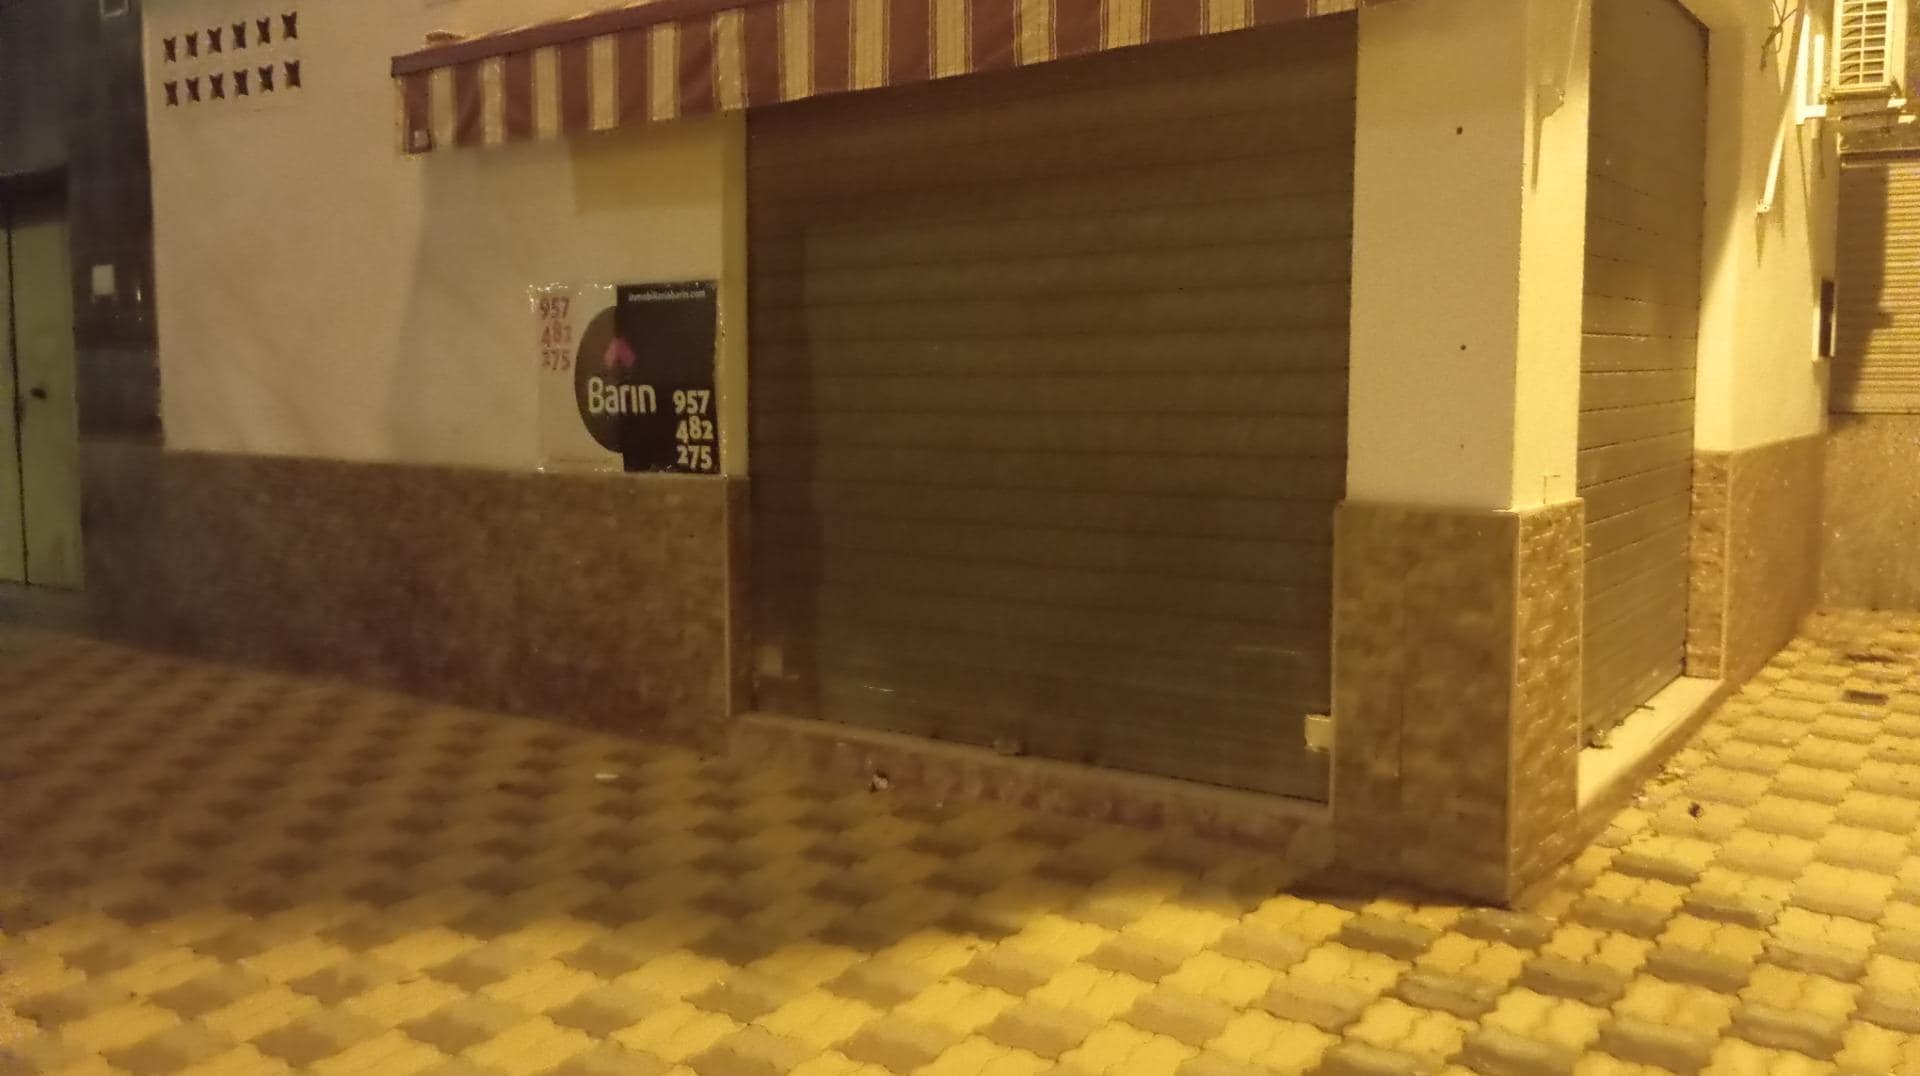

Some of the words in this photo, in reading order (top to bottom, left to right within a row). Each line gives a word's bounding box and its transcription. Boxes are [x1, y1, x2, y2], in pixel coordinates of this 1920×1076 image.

[539, 297, 569, 319] 957
[588, 376, 657, 414] Barin
[672, 390, 710, 414] 957
[676, 416, 713, 443] 482
[676, 445, 712, 470] 275
